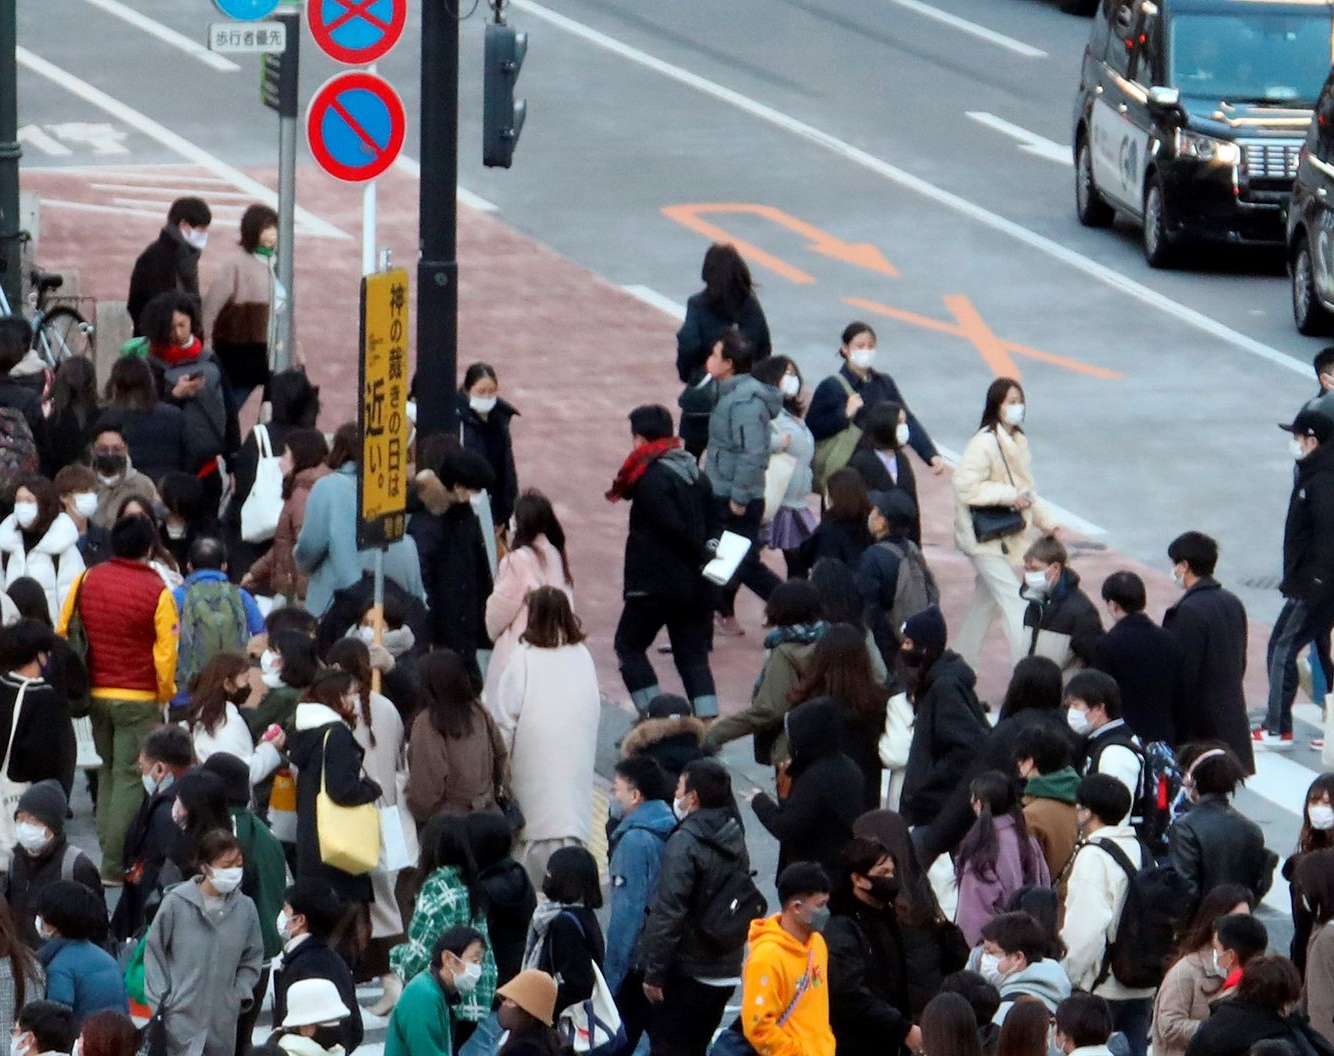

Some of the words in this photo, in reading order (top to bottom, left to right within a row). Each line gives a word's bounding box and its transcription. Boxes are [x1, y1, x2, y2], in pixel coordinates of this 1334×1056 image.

[217, 30, 282, 46] 歩行者優先
